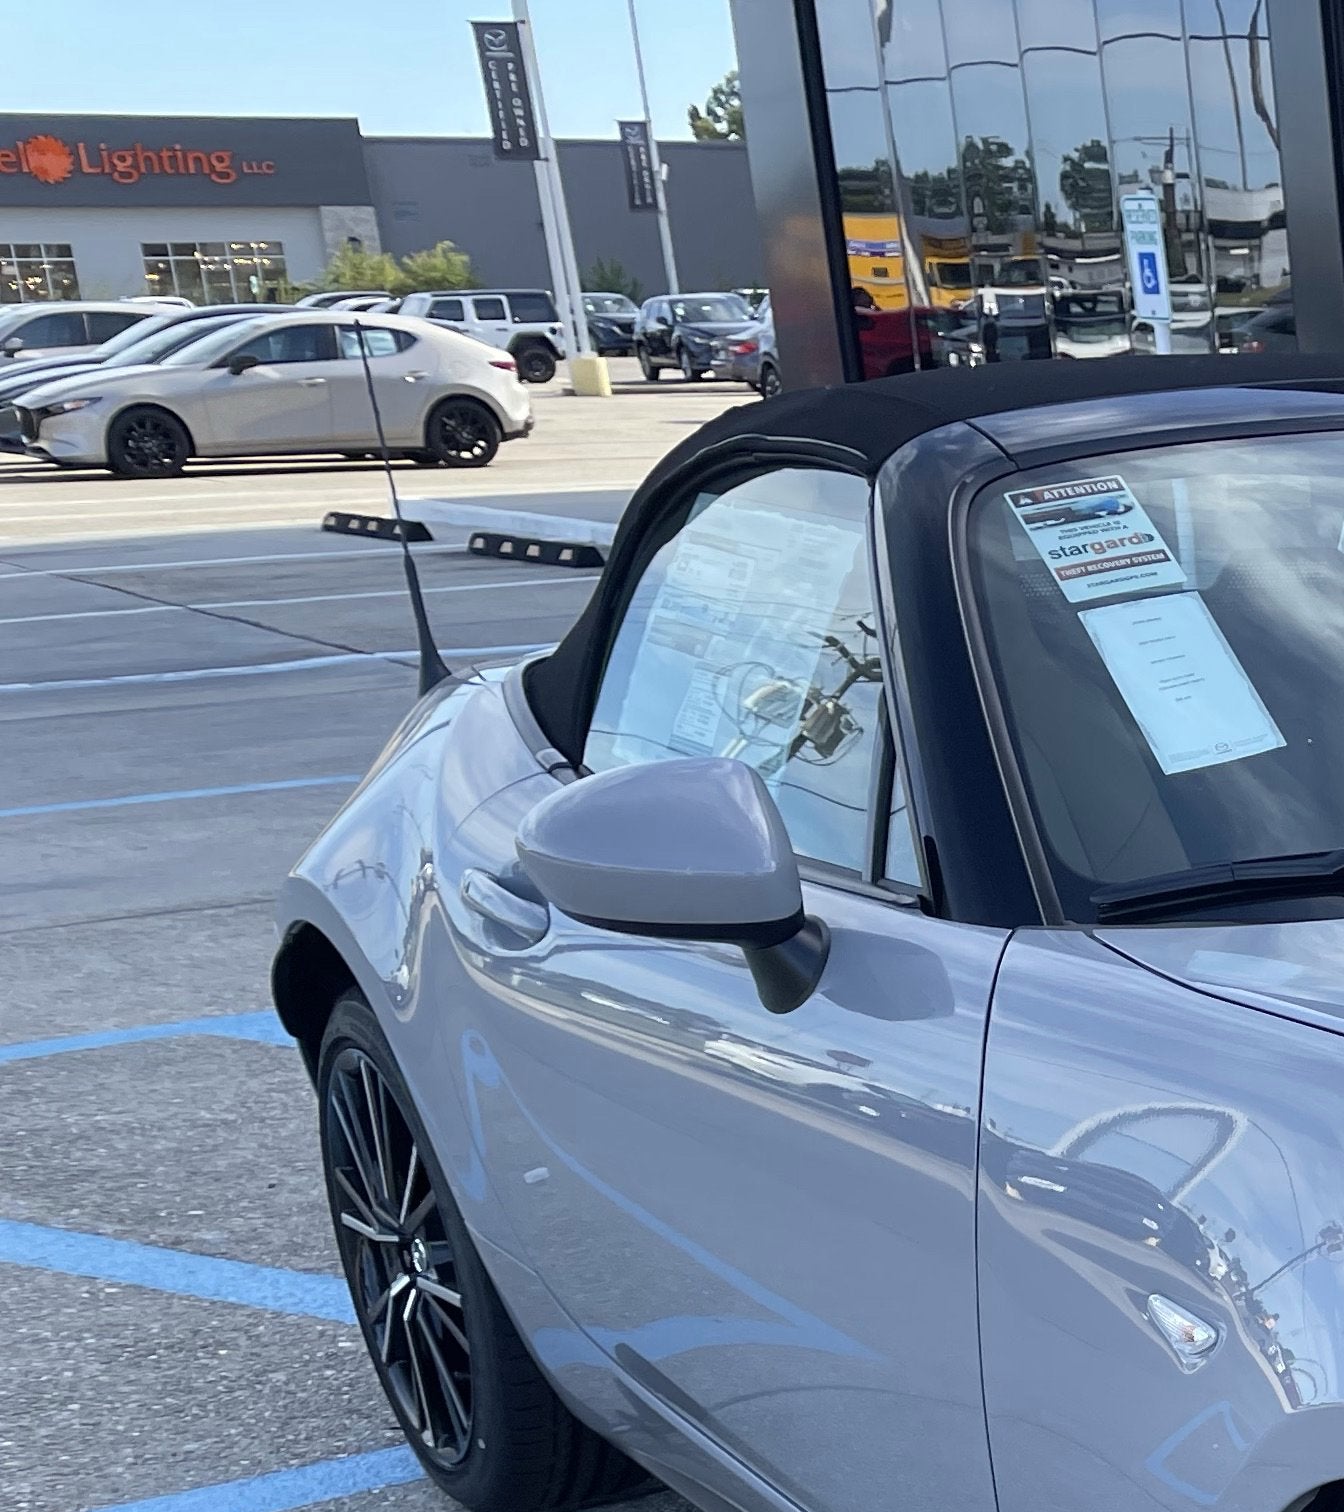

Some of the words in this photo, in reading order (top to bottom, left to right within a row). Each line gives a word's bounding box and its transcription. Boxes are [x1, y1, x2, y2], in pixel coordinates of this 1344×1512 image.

[77, 143, 238, 185] Lighting
[242, 160, 276, 175] LLC
[1043, 480, 1119, 501] ATTENTION
[1087, 558, 1131, 572] RECOVERY
[1132, 552, 1166, 565] SYSTEM
